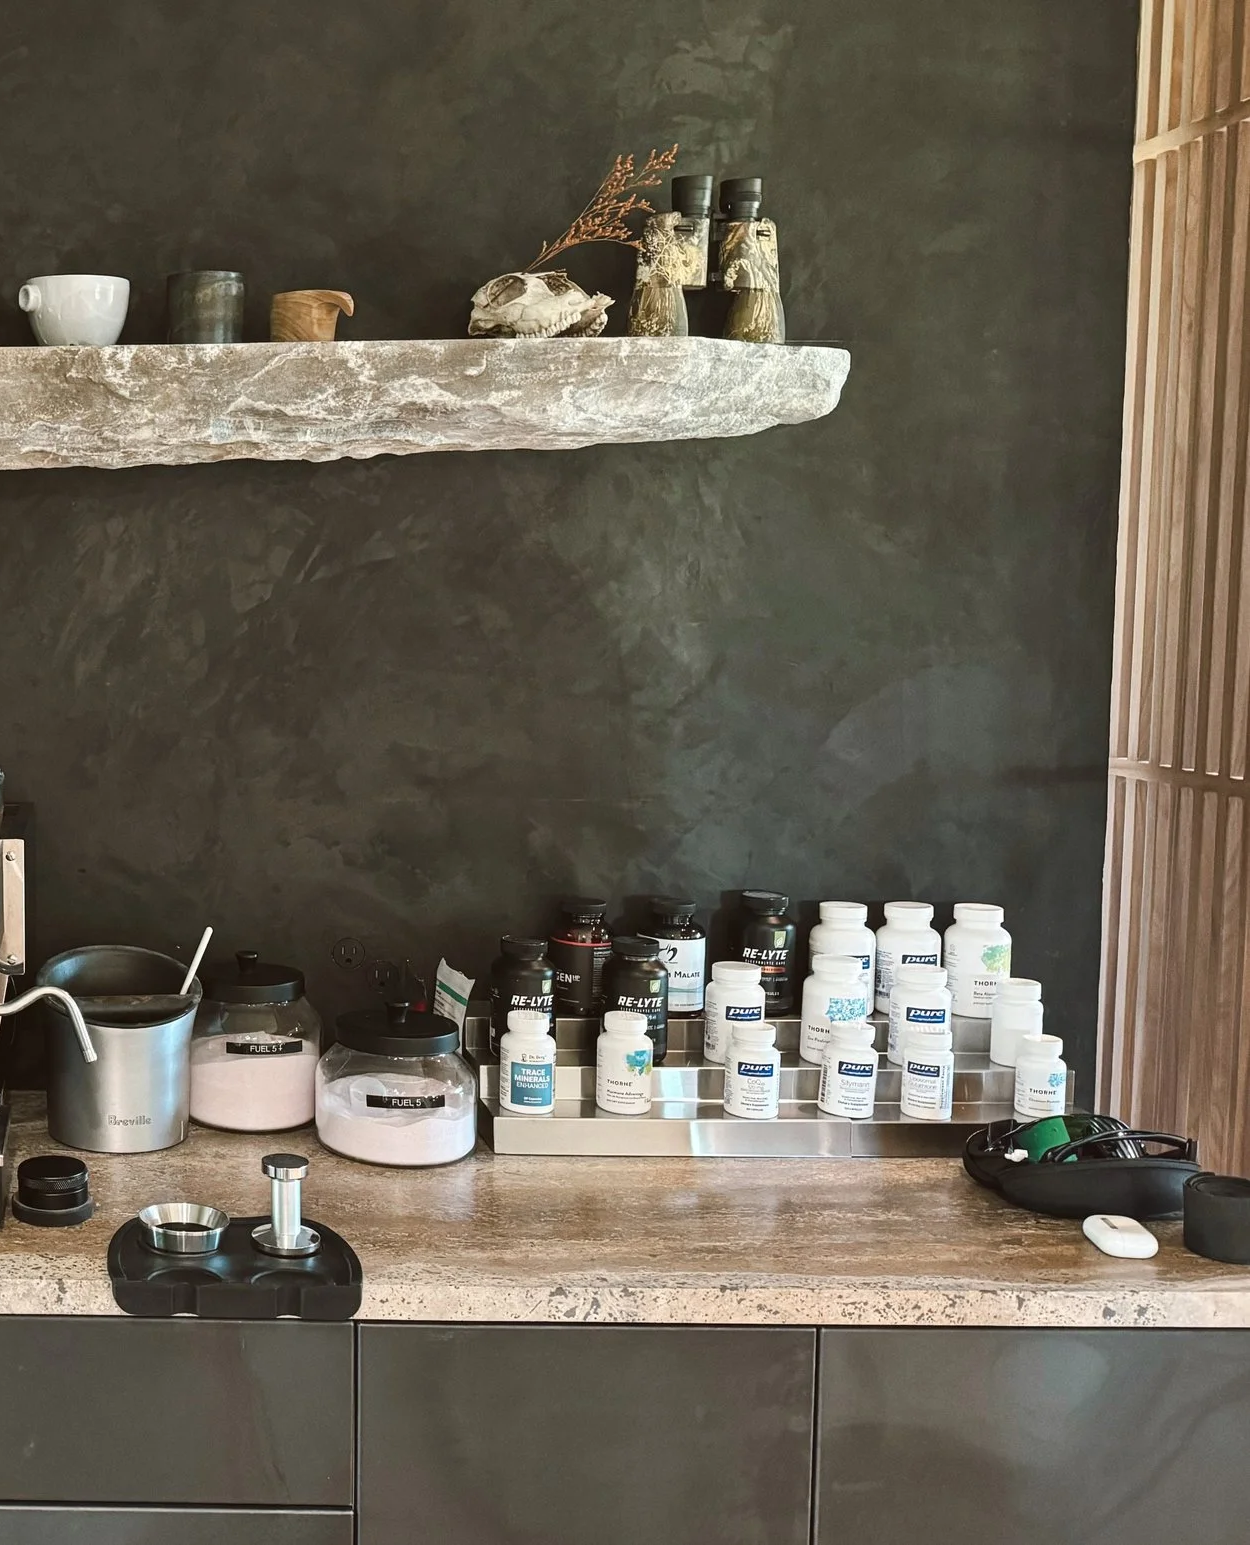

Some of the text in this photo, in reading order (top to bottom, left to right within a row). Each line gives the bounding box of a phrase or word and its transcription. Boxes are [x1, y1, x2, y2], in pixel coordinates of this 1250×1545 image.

[742, 947, 790, 960] RE-LYTE
[905, 956, 937, 964] pure
[511, 994, 554, 1007] RE-LYTE
[618, 996, 664, 1008] RE-LYTE
[729, 1008, 761, 1016] pure
[909, 1009, 945, 1017] pure
[250, 1045, 271, 1053] FUEL
[740, 1063, 773, 1071] pure
[841, 1063, 873, 1071] pure
[910, 1062, 939, 1072] pure
[521, 1068, 546, 1076] TRACE
[514, 1074, 551, 1083] MINERALS
[516, 1081, 549, 1089] ENHANCED
[391, 1098, 422, 1107] FUEL 5
[107, 1114, 152, 1127] Breville
